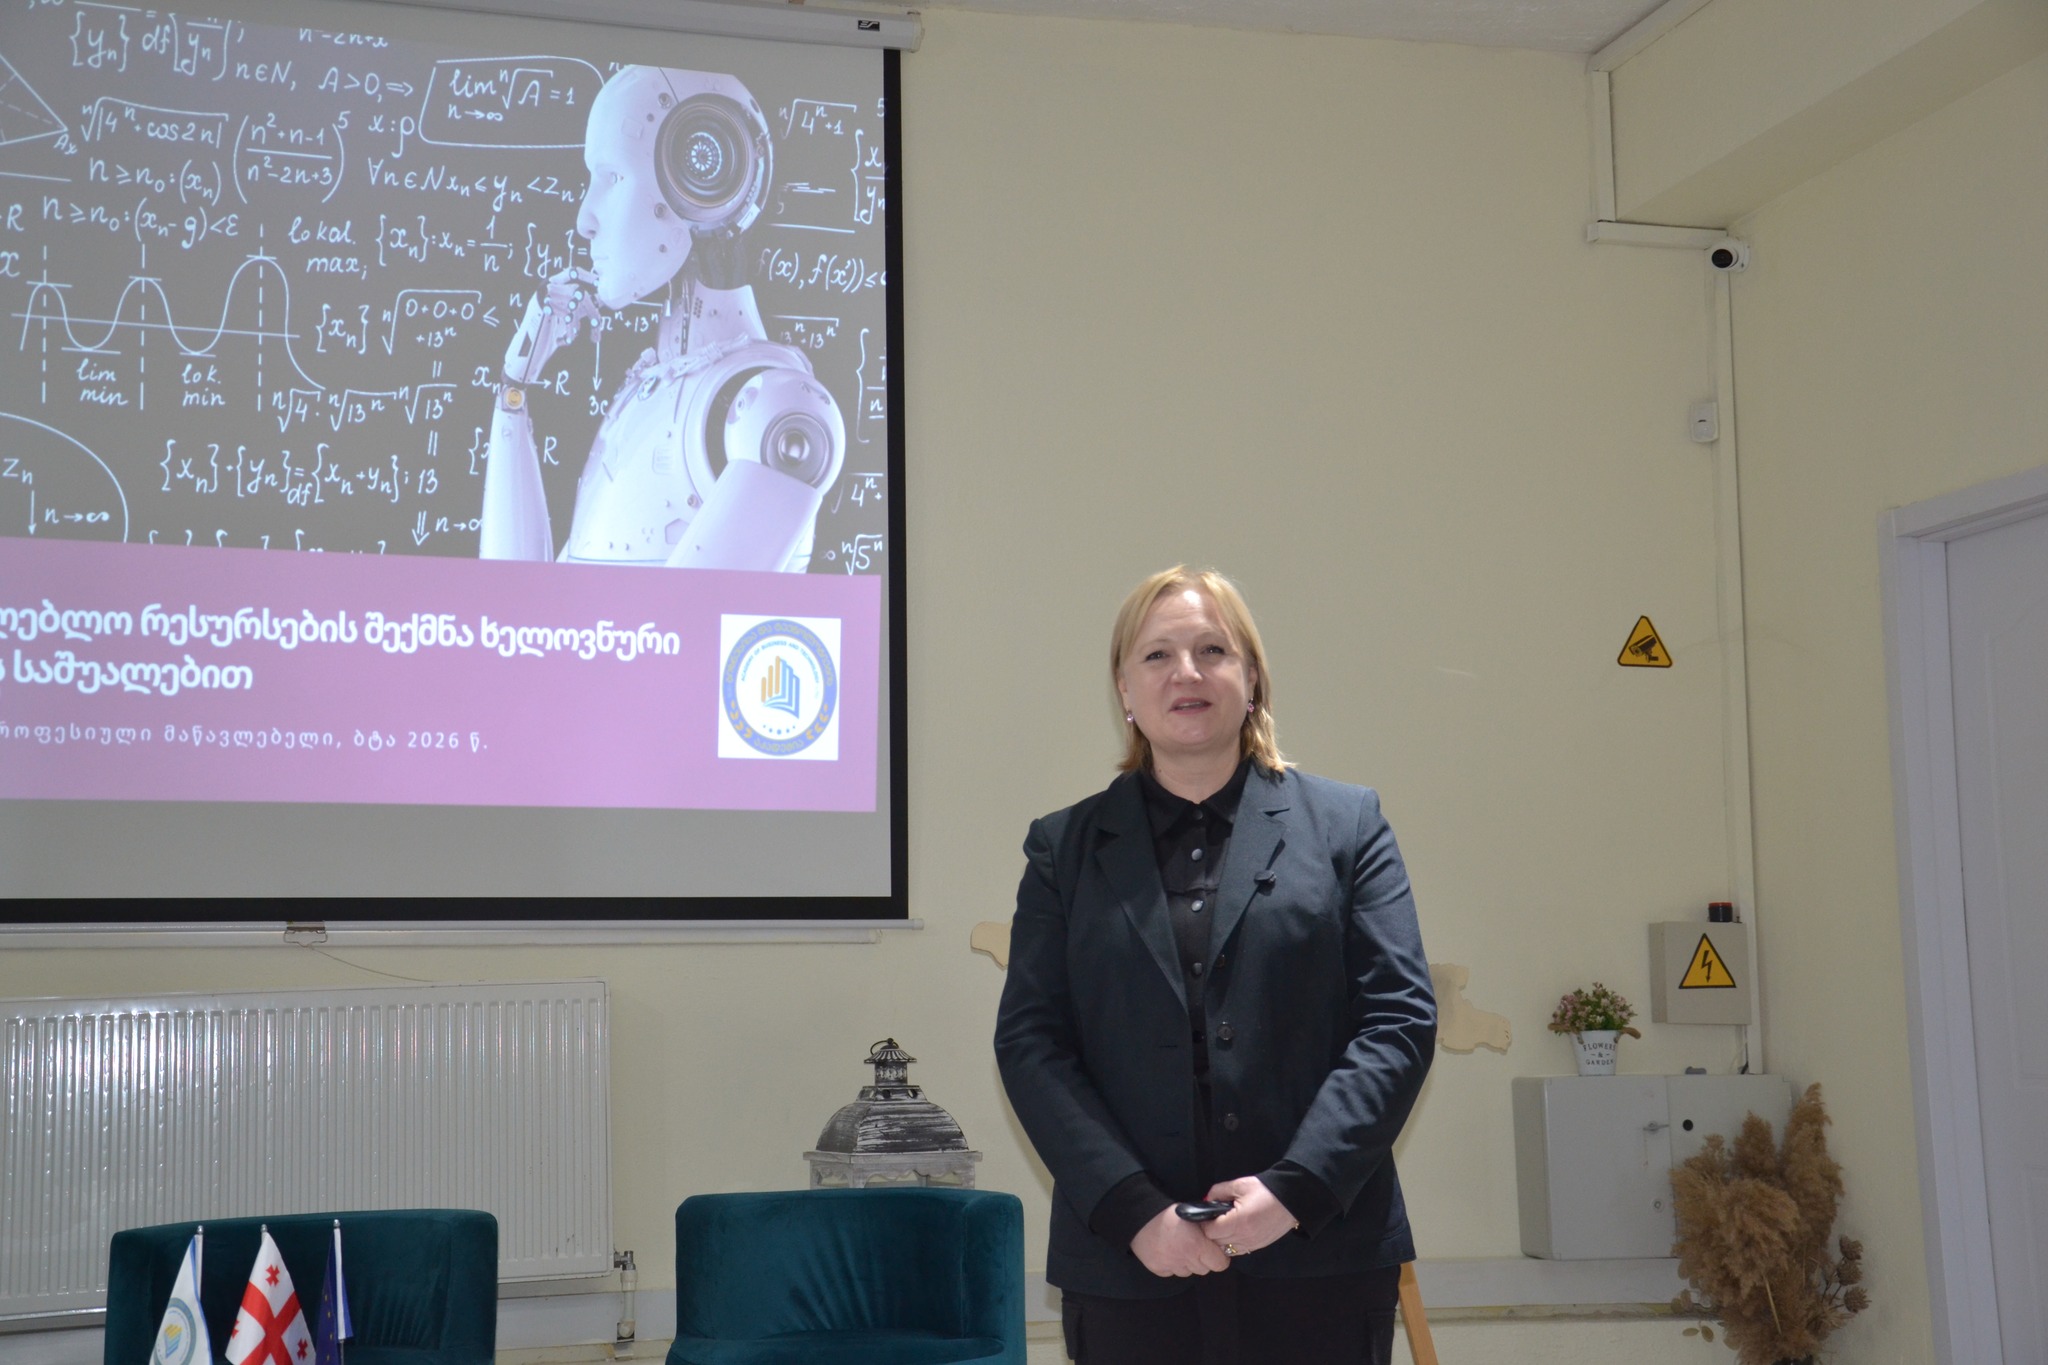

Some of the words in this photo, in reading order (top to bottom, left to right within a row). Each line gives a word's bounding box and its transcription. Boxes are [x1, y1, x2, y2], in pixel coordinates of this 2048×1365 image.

[141, 603, 359, 650] რესურსების
[364, 611, 474, 654] შექმნა
[480, 615, 681, 662] ხელოვნური
[13, 648, 254, 697] საშუალებით
[164, 724, 342, 750] მაწავლებელი,
[408, 731, 460, 749] 2026
